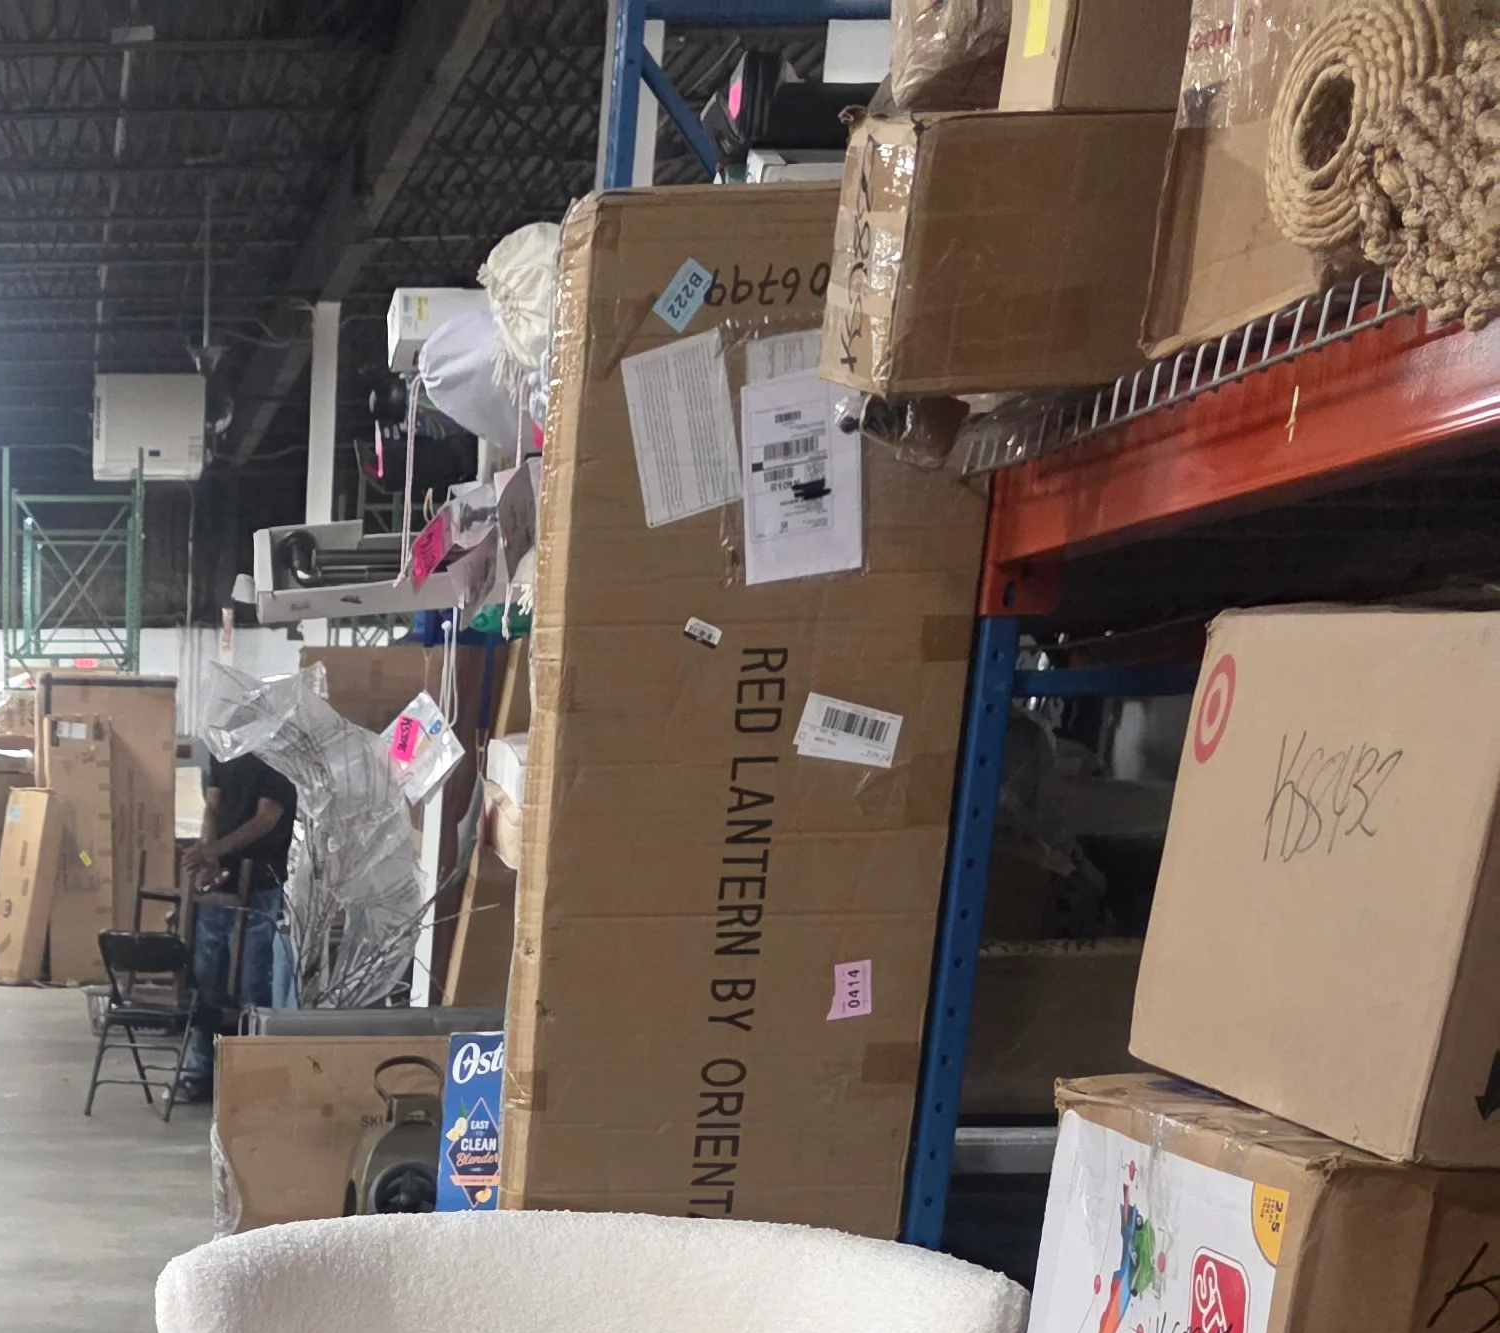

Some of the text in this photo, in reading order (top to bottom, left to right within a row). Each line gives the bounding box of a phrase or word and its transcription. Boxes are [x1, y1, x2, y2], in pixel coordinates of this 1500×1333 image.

[667, 271, 704, 321] B222
[733, 647, 788, 733] RED
[714, 755, 779, 957] LANTERN
[708, 978, 757, 1032] BY
[847, 968, 861, 1009] 0414
[456, 1152, 499, 1167] Blender
[460, 1138, 497, 1152] CLEAN
[687, 1058, 747, 1219] ORIENT
[1271, 1200, 1284, 1233] 2-5
